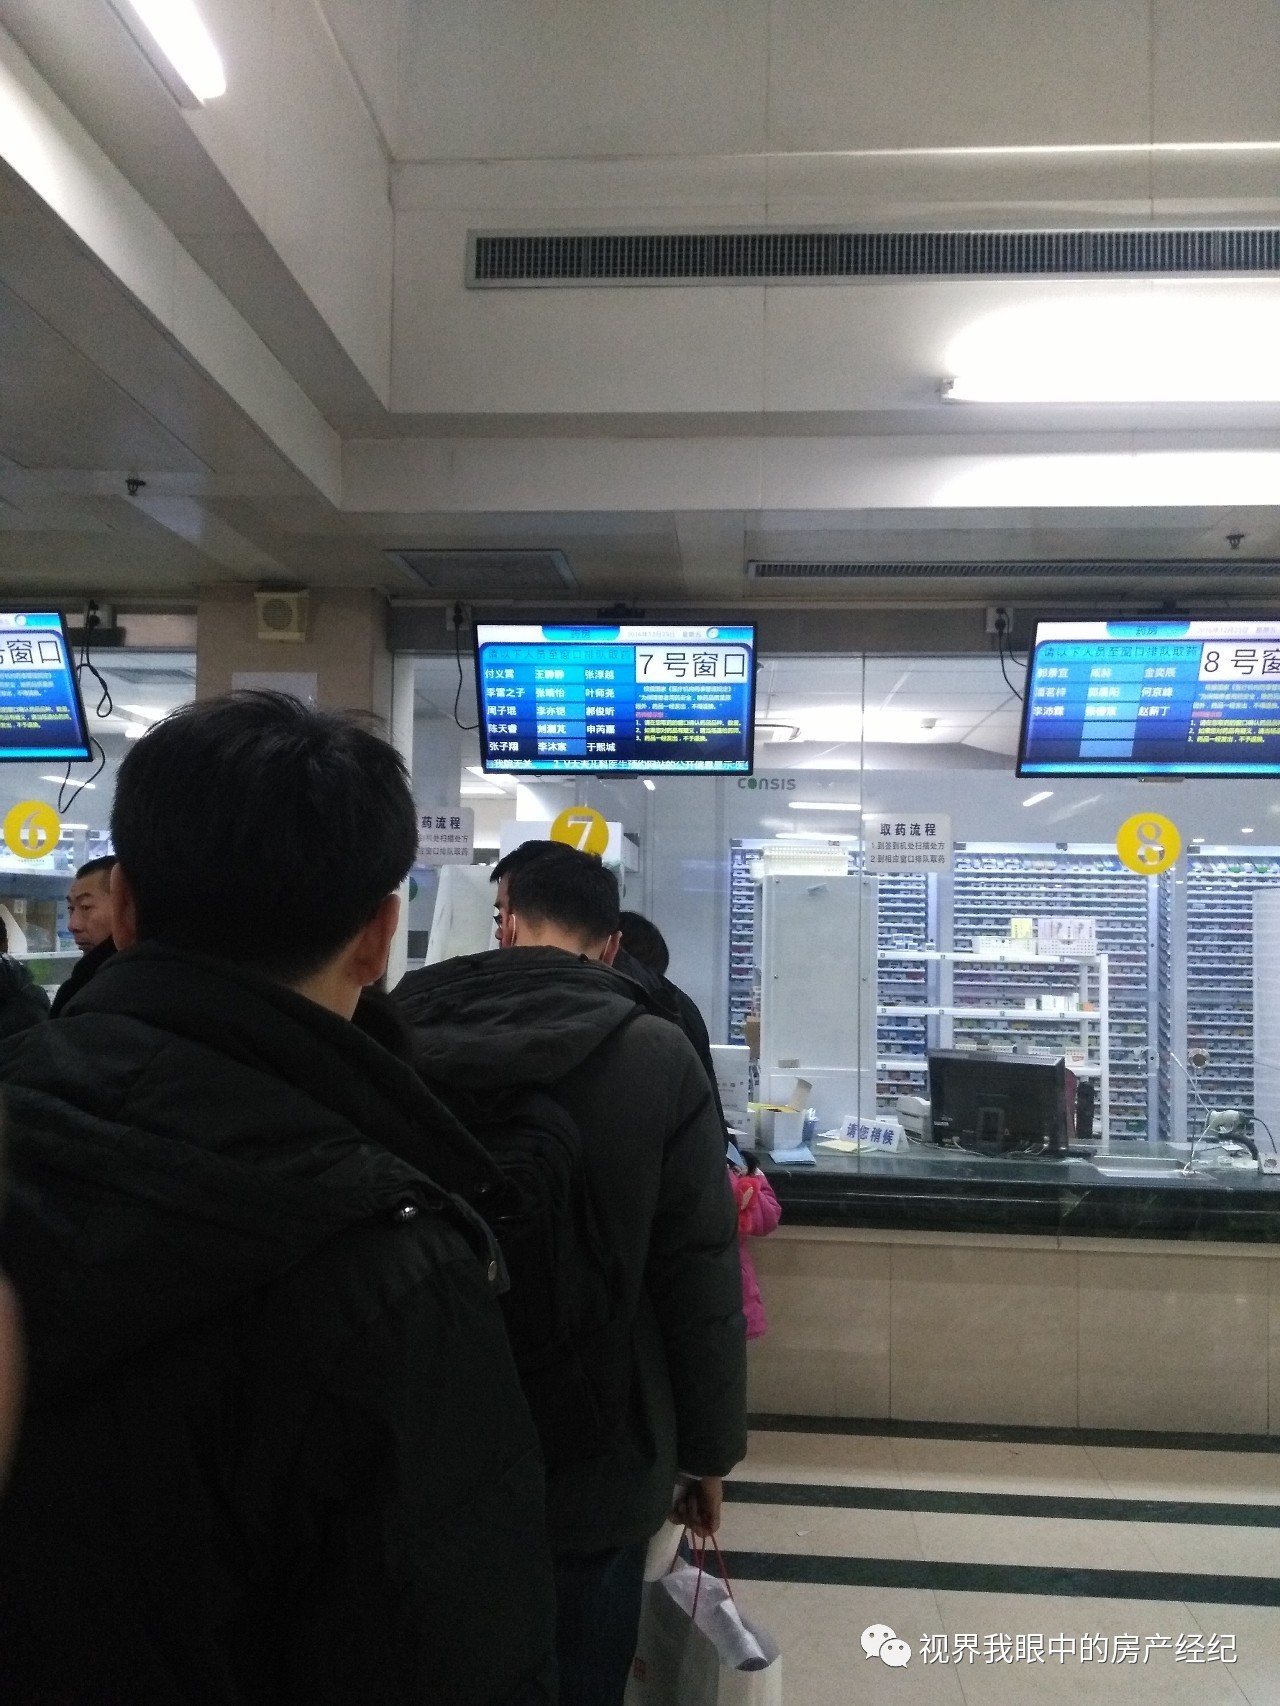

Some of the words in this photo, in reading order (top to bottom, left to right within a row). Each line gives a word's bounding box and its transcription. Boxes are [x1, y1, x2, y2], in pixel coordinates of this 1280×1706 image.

[488, 649, 631, 660] 请以下人员至窗口排队取药
[1043, 645, 1199, 657] 请以下人员至窗口排队取药
[19, 808, 47, 851] 6
[421, 815, 461, 830] 药流程
[567, 814, 595, 851] 7
[879, 822, 937, 837] 取药流程
[1136, 821, 1166, 866] 8
[845, 1121, 896, 1146] 请您稍候
